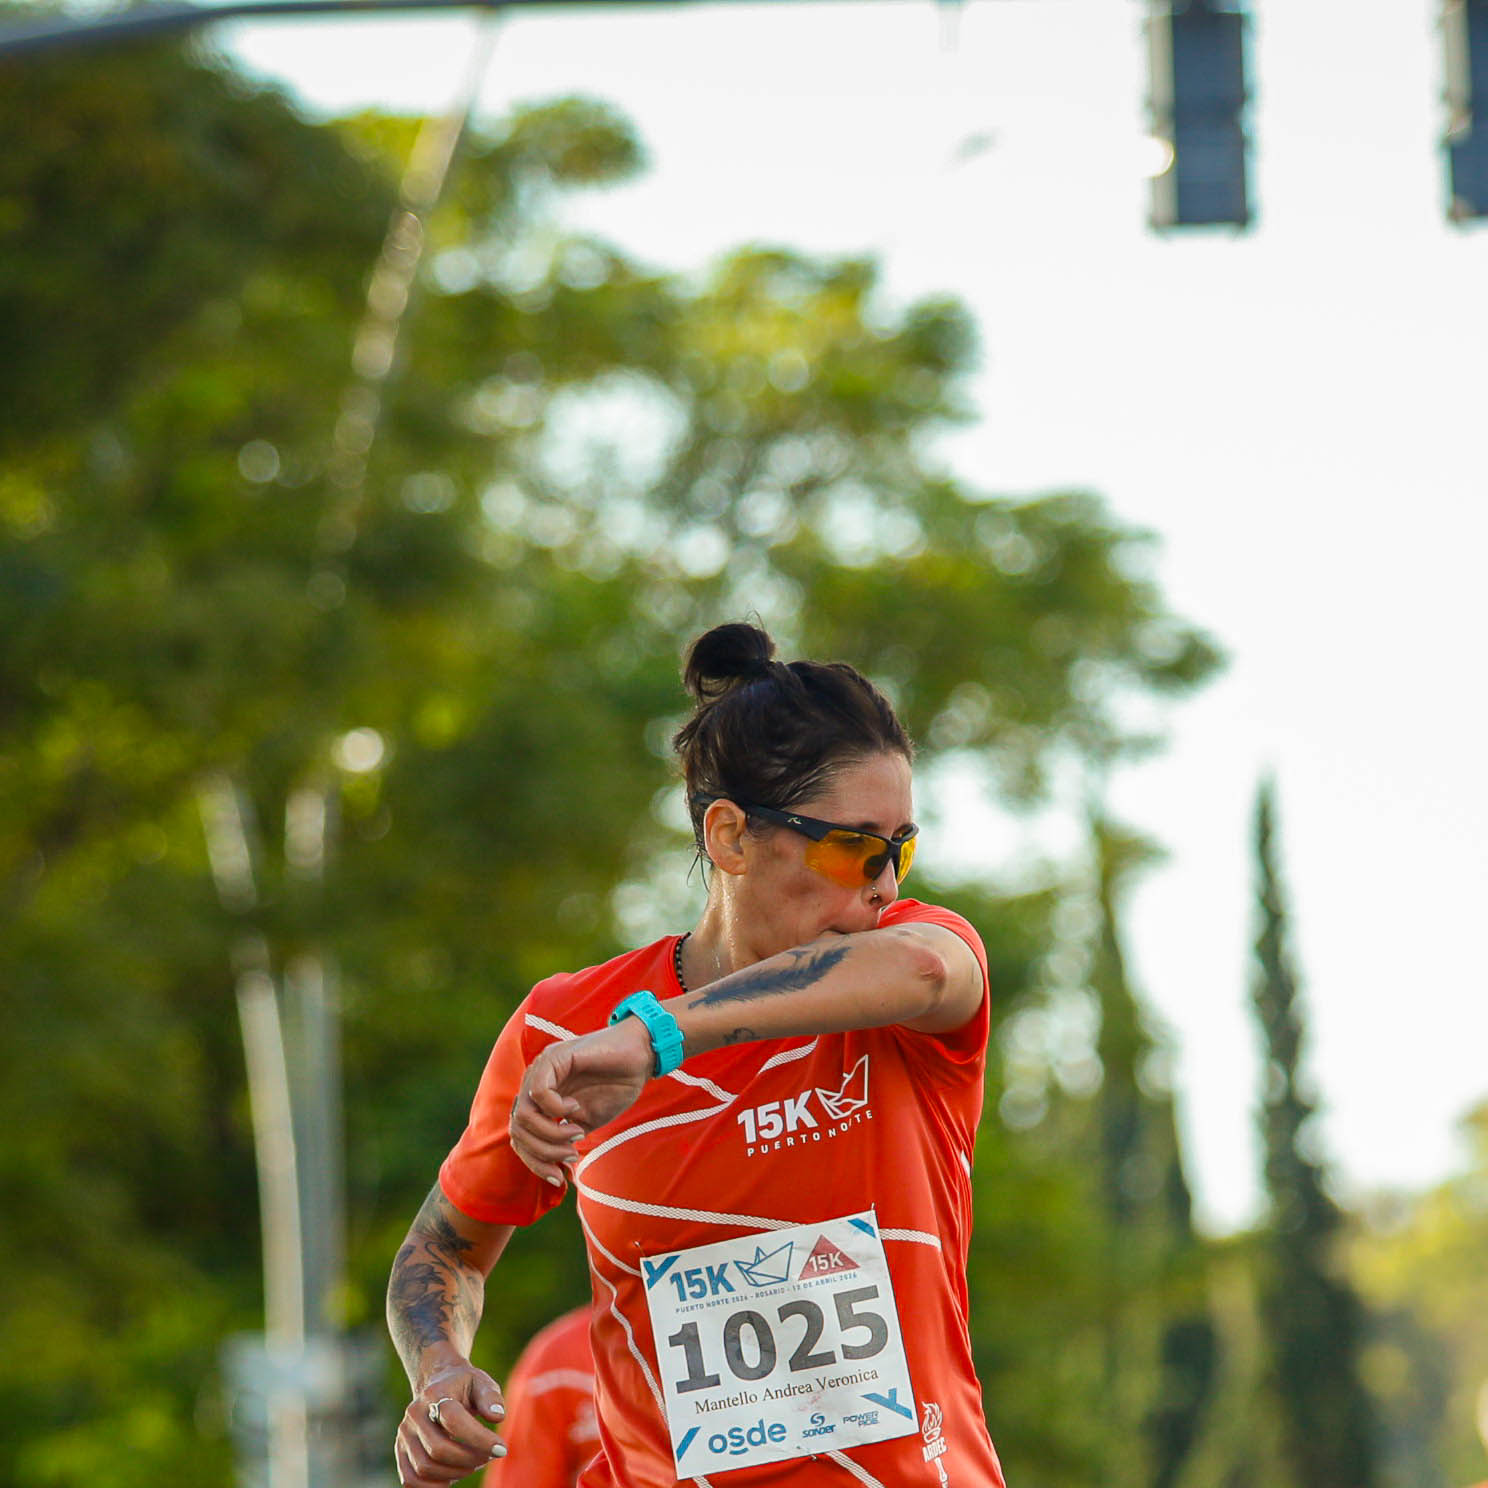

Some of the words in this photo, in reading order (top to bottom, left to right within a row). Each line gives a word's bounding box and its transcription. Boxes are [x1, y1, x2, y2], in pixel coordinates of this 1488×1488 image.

[737, 1089, 818, 1144] 15K
[747, 1132, 821, 1157] PUERTO
[808, 1251, 845, 1272] 15K
[669, 1263, 736, 1301] 15K
[676, 1303, 704, 1313] PUERTO
[706, 1298, 729, 1307] NORTE
[755, 1287, 785, 1298] ROSARIO
[803, 1281, 813, 1289] DE
[815, 1277, 837, 1286] ABRIL
[668, 1284, 889, 1394] 1025
[695, 1391, 758, 1415] Mantello
[763, 1383, 813, 1401] Andrea
[816, 1368, 879, 1391] Veronica
[708, 1418, 787, 1455] osde
[922, 1436, 947, 1463] ARDEC
